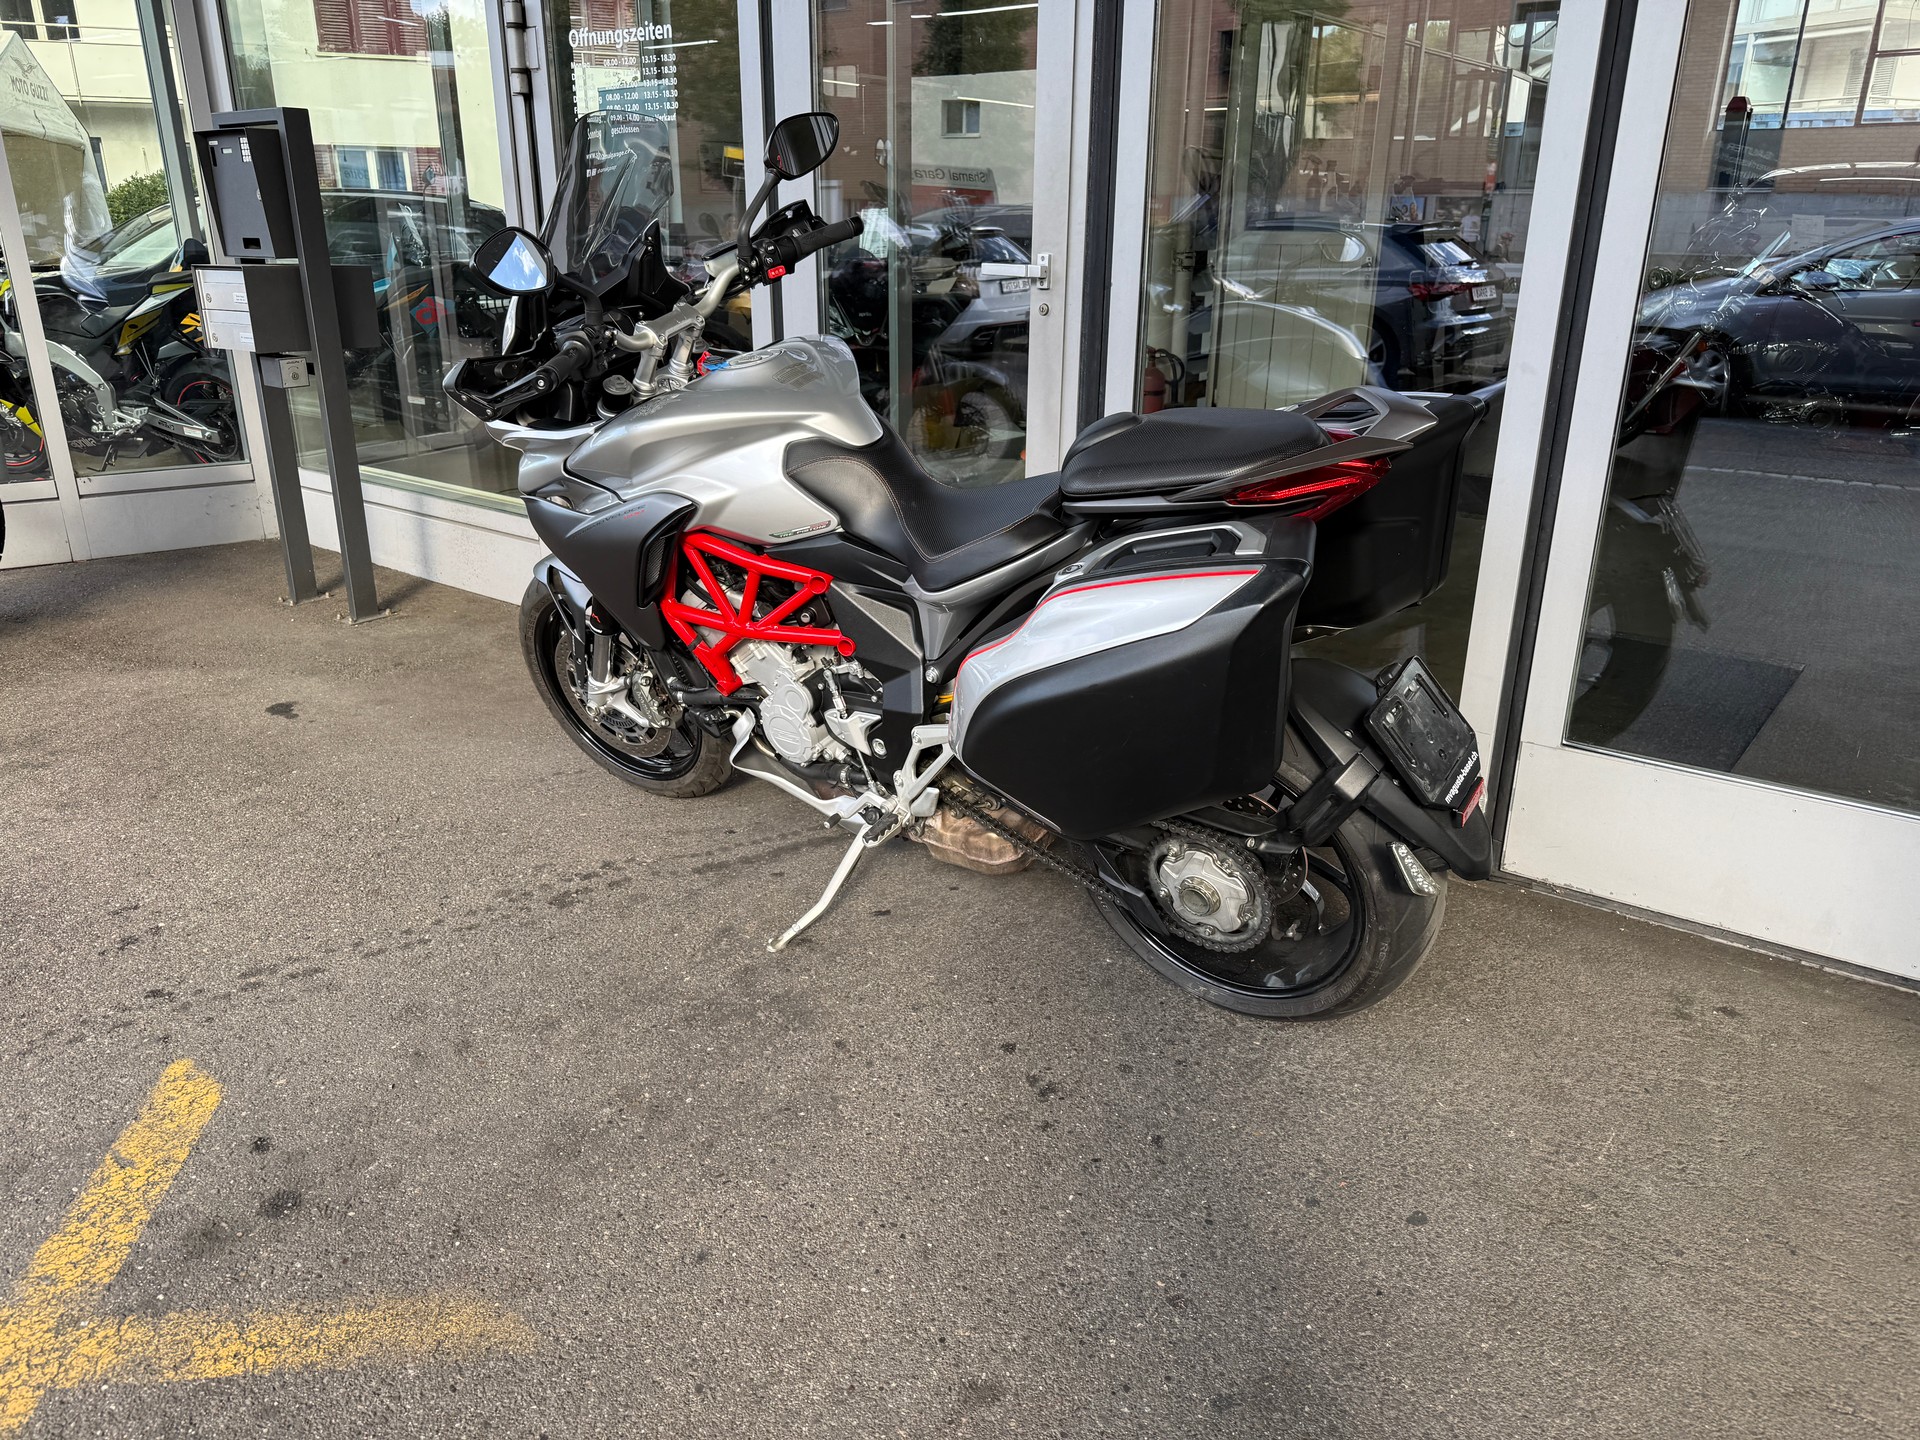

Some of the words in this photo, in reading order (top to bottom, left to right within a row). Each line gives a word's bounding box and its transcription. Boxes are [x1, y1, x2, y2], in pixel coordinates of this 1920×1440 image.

[642, 55, 656, 63] 13.15
[661, 54, 676, 62] 18.30
[642, 67, 657, 75] 13.15
[661, 66, 677, 74] 18.30
[662, 78, 677, 86] 18.30
[10, 75, 29, 96] MOTO
[30, 82, 49, 102] GUZZI
[606, 93, 620, 101] 08.00
[644, 91, 658, 99] 13.15
[663, 89, 678, 97] 18.30
[645, 102, 659, 110] 13.15
[664, 101, 679, 109] 18.30
[611, 125, 640, 138] geschlossen
[1445, 751, 1479, 804] mvagusta-basel.ch
